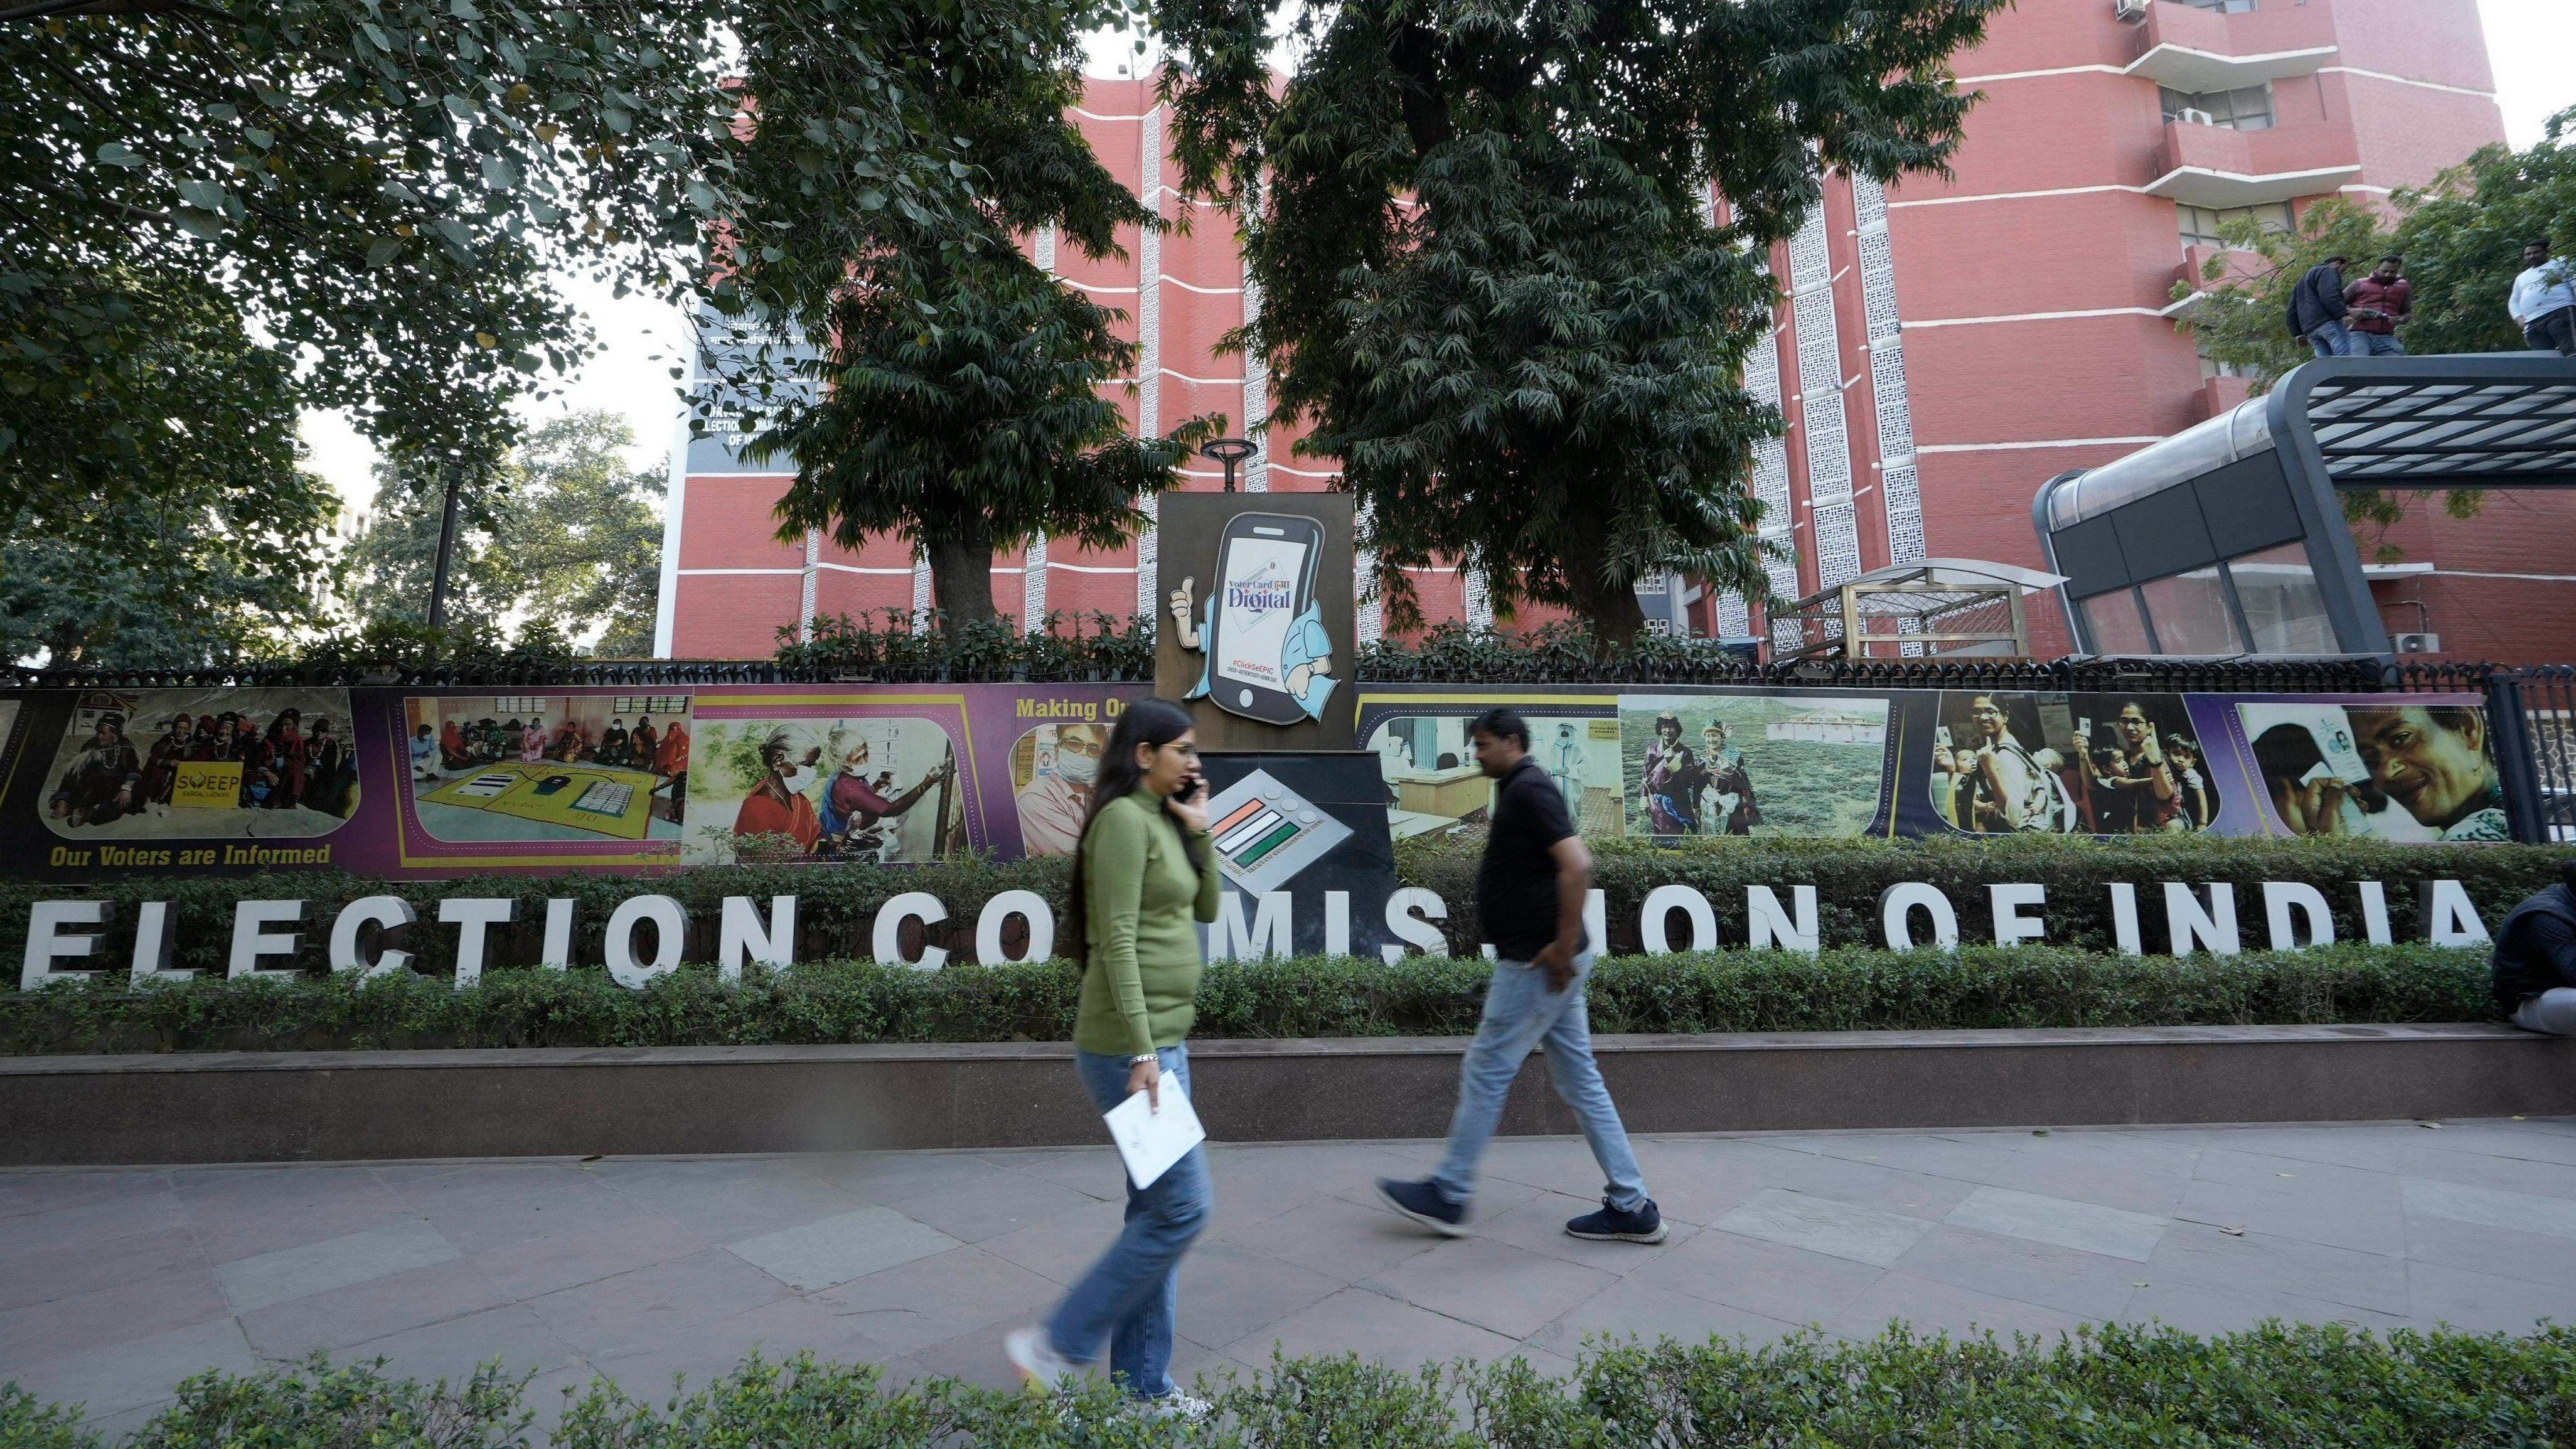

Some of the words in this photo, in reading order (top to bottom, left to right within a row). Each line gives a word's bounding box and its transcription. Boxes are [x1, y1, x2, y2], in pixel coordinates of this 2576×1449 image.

[728, 434, 743, 446] OF
[1228, 588, 1291, 614] Digital
[1232, 659, 1275, 675] #ClickSeEPIC
[1015, 698, 1098, 722] Making
[50, 846, 92, 867] Our
[99, 845, 172, 867] Voters
[178, 848, 215, 865] are
[223, 843, 331, 865] Informed
[19, 895, 800, 992] ELECTION
[872, 884, 1819, 970] COMISION
[1874, 882, 2046, 950] OF
[2102, 880, 2493, 954] INDIA
